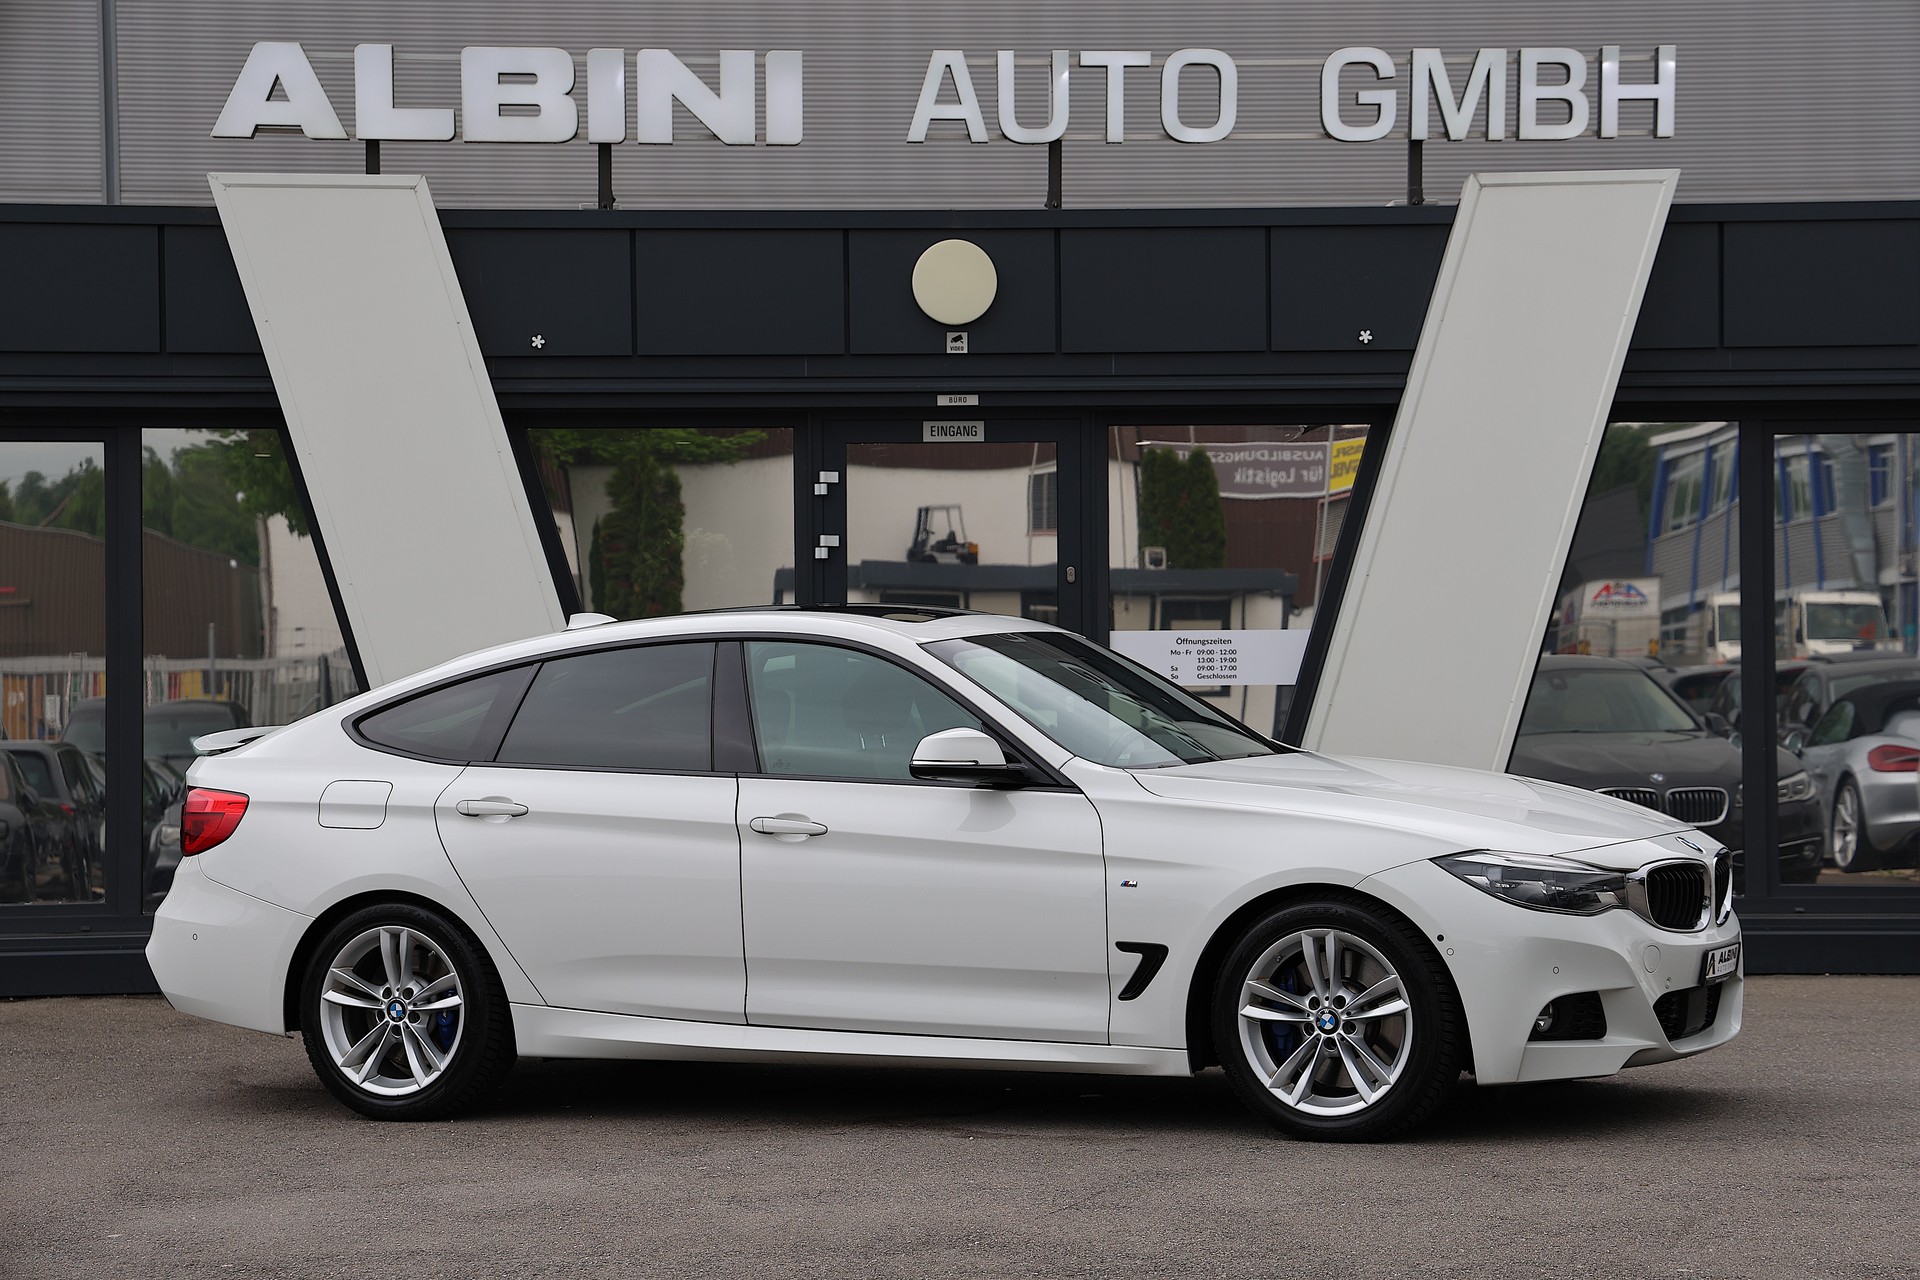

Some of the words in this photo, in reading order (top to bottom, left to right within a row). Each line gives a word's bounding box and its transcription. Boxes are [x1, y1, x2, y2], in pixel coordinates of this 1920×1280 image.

[210, 41, 803, 146] ALBINI
[906, 47, 1238, 143] AUTO
[1320, 44, 1677, 142] GMBH
[948, 395, 968, 404] BÜRO
[930, 425, 978, 437] EINGANG
[1175, 636, 1232, 647] Öffnungszeiten
